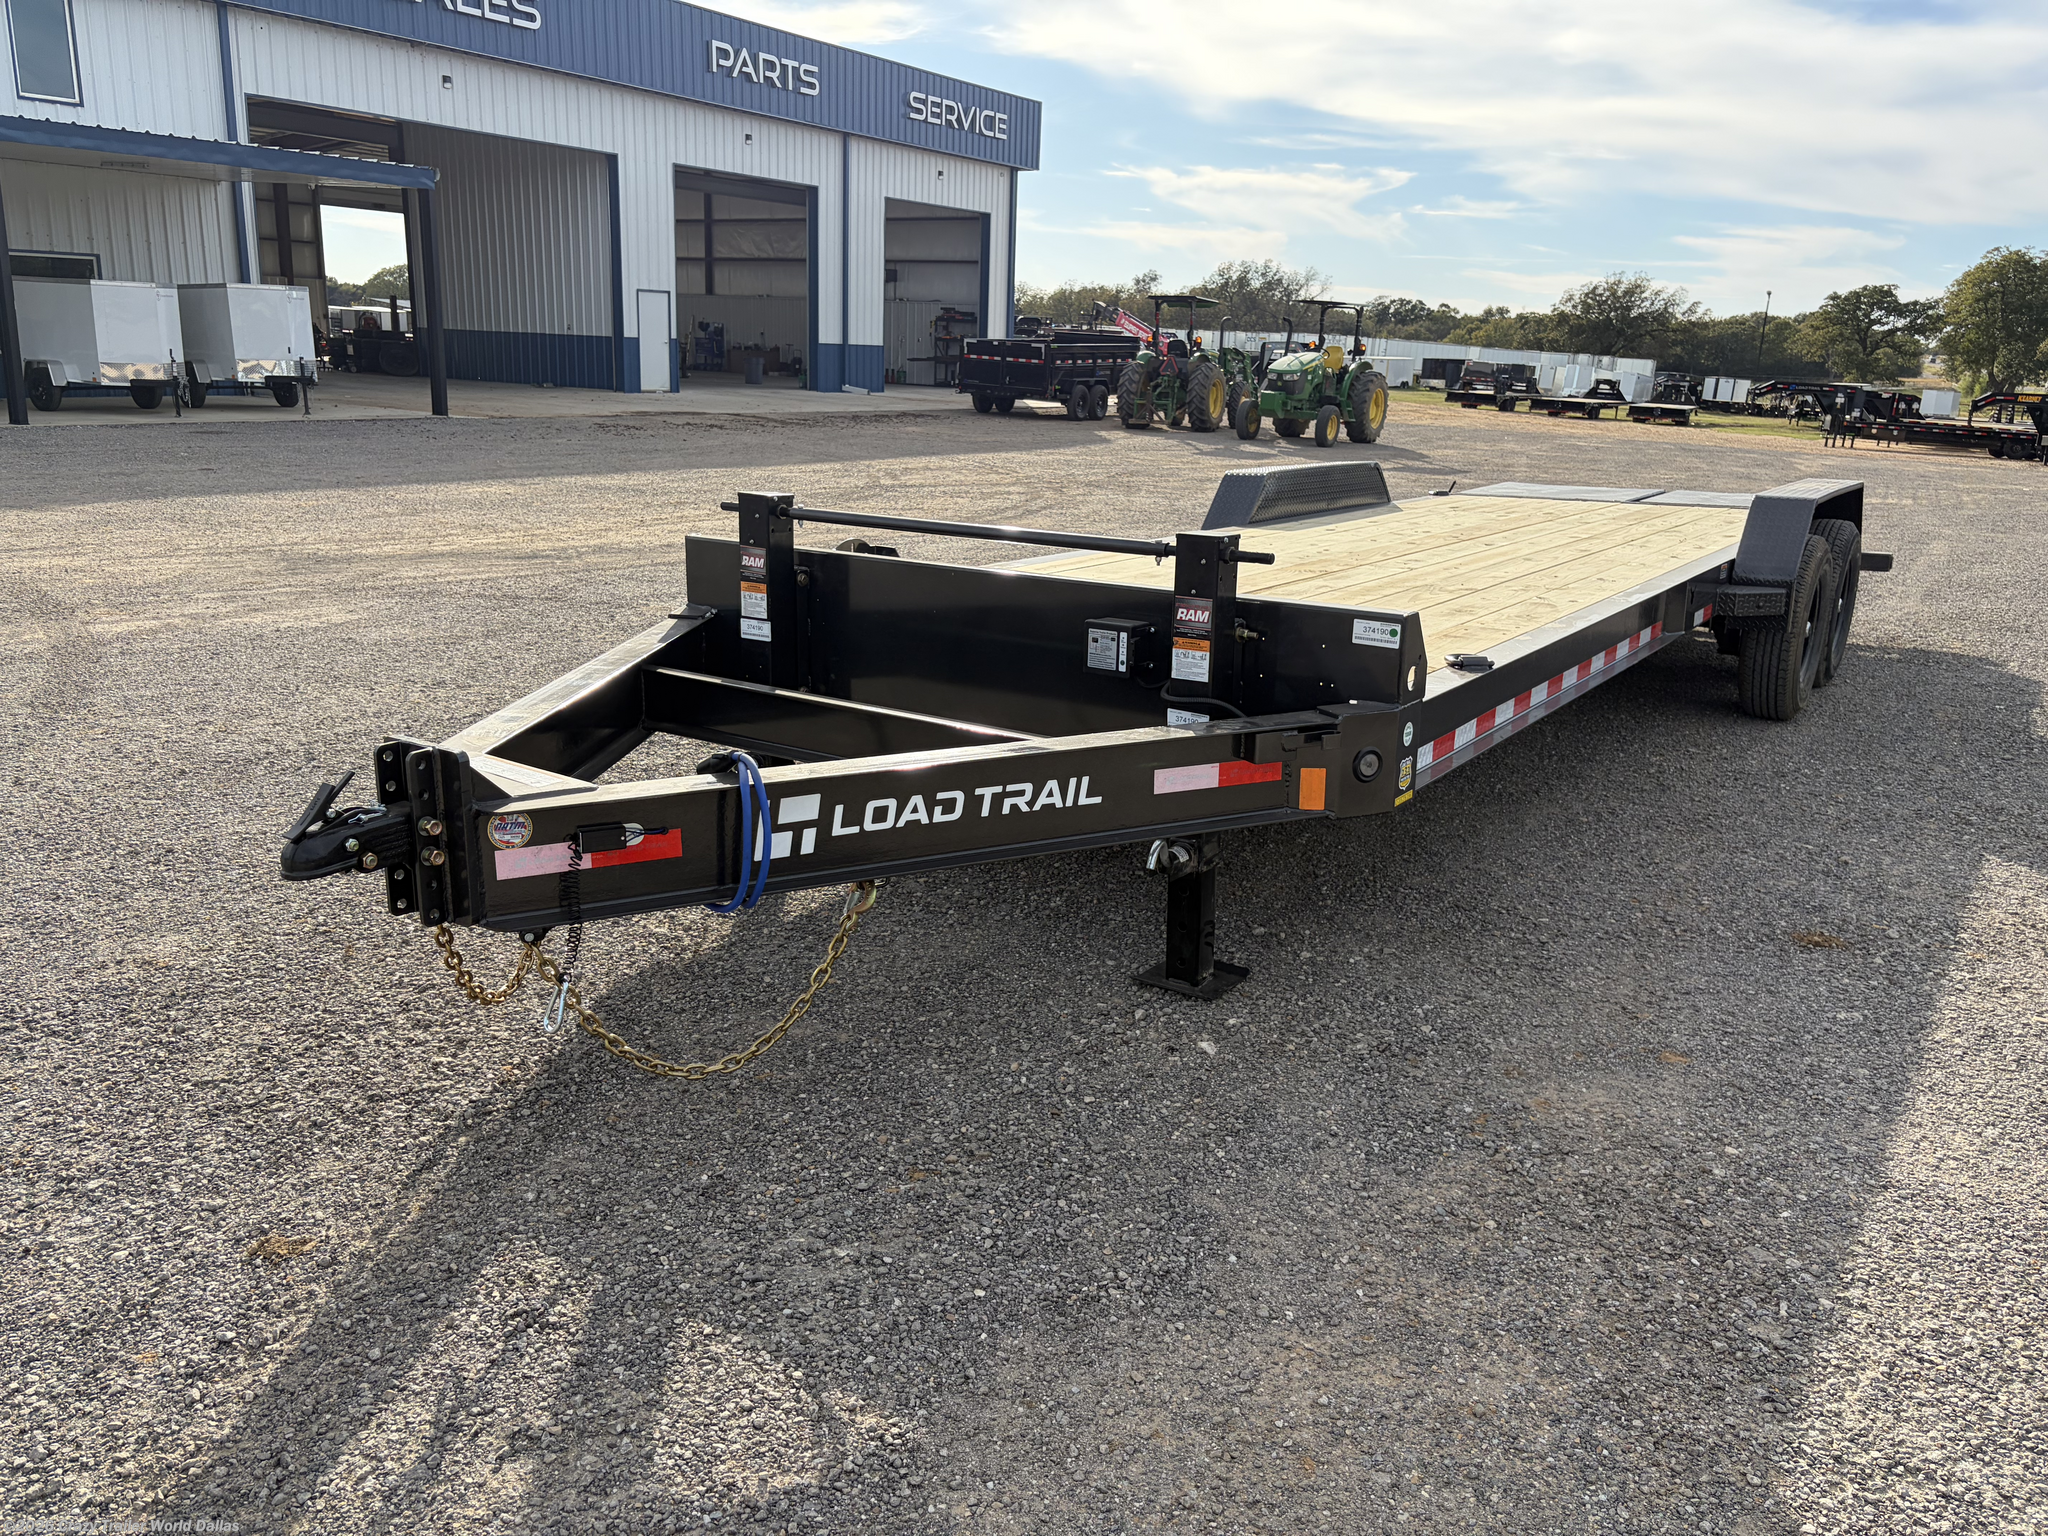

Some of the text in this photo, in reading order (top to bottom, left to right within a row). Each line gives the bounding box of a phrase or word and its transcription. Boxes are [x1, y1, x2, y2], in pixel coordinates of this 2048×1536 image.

[710, 39, 820, 96] PARTS
[908, 91, 1008, 140] SERVICE
[741, 555, 765, 568] RAM
[1176, 608, 1210, 623] RAM
[1362, 625, 1389, 636] 374190
[831, 775, 1103, 837] LOAD TRAIL
